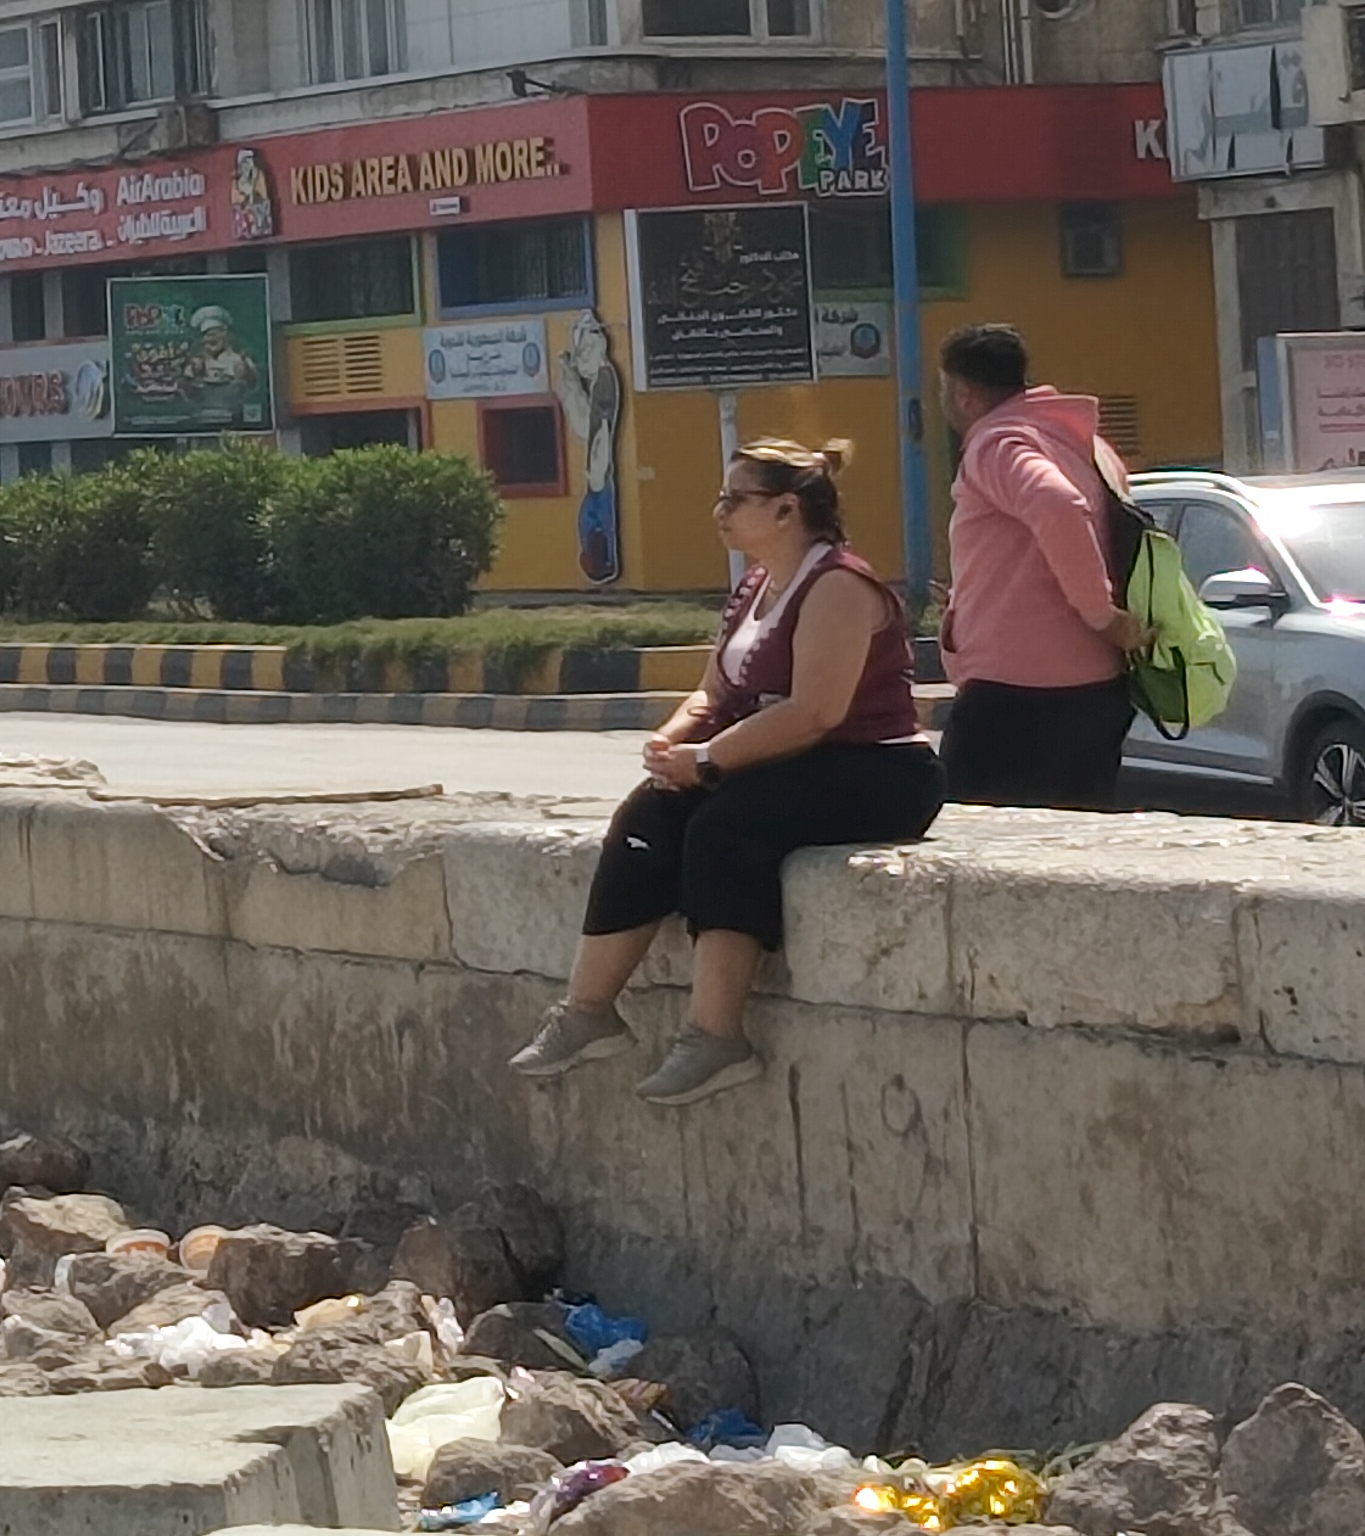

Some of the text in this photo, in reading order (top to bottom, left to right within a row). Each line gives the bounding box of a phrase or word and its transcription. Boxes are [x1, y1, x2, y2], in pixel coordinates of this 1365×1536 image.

[680, 99, 885, 194] POPEYE
[291, 162, 344, 205] KIDS
[351, 154, 414, 198] AREA
[420, 147, 469, 190] AND
[820, 168, 888, 191] PARK
[34, 182, 103, 220] وكيل
